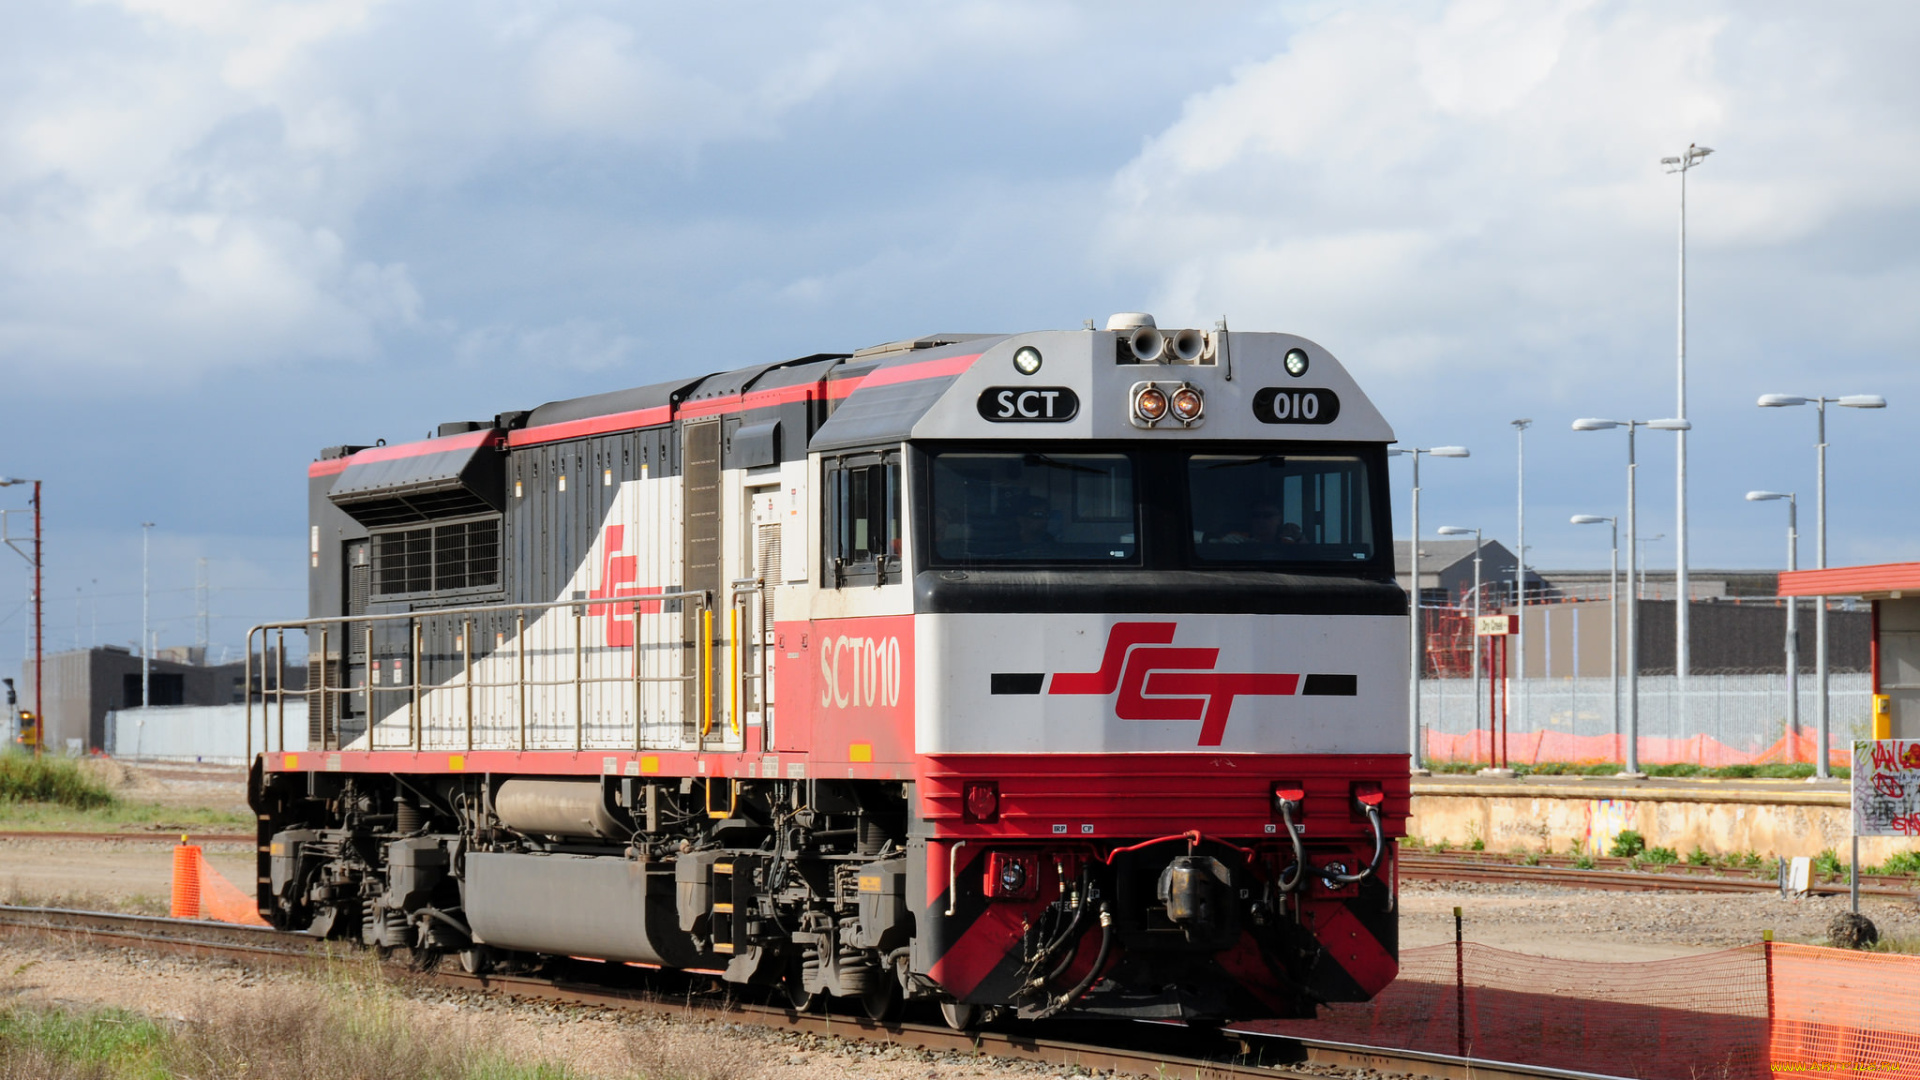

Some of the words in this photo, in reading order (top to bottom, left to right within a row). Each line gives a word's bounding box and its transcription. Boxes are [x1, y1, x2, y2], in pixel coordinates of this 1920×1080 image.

[997, 390, 1060, 419] SCT
[1273, 392, 1319, 420] 010
[820, 634, 901, 710] SCT010
[1048, 622, 1300, 746] SCT
